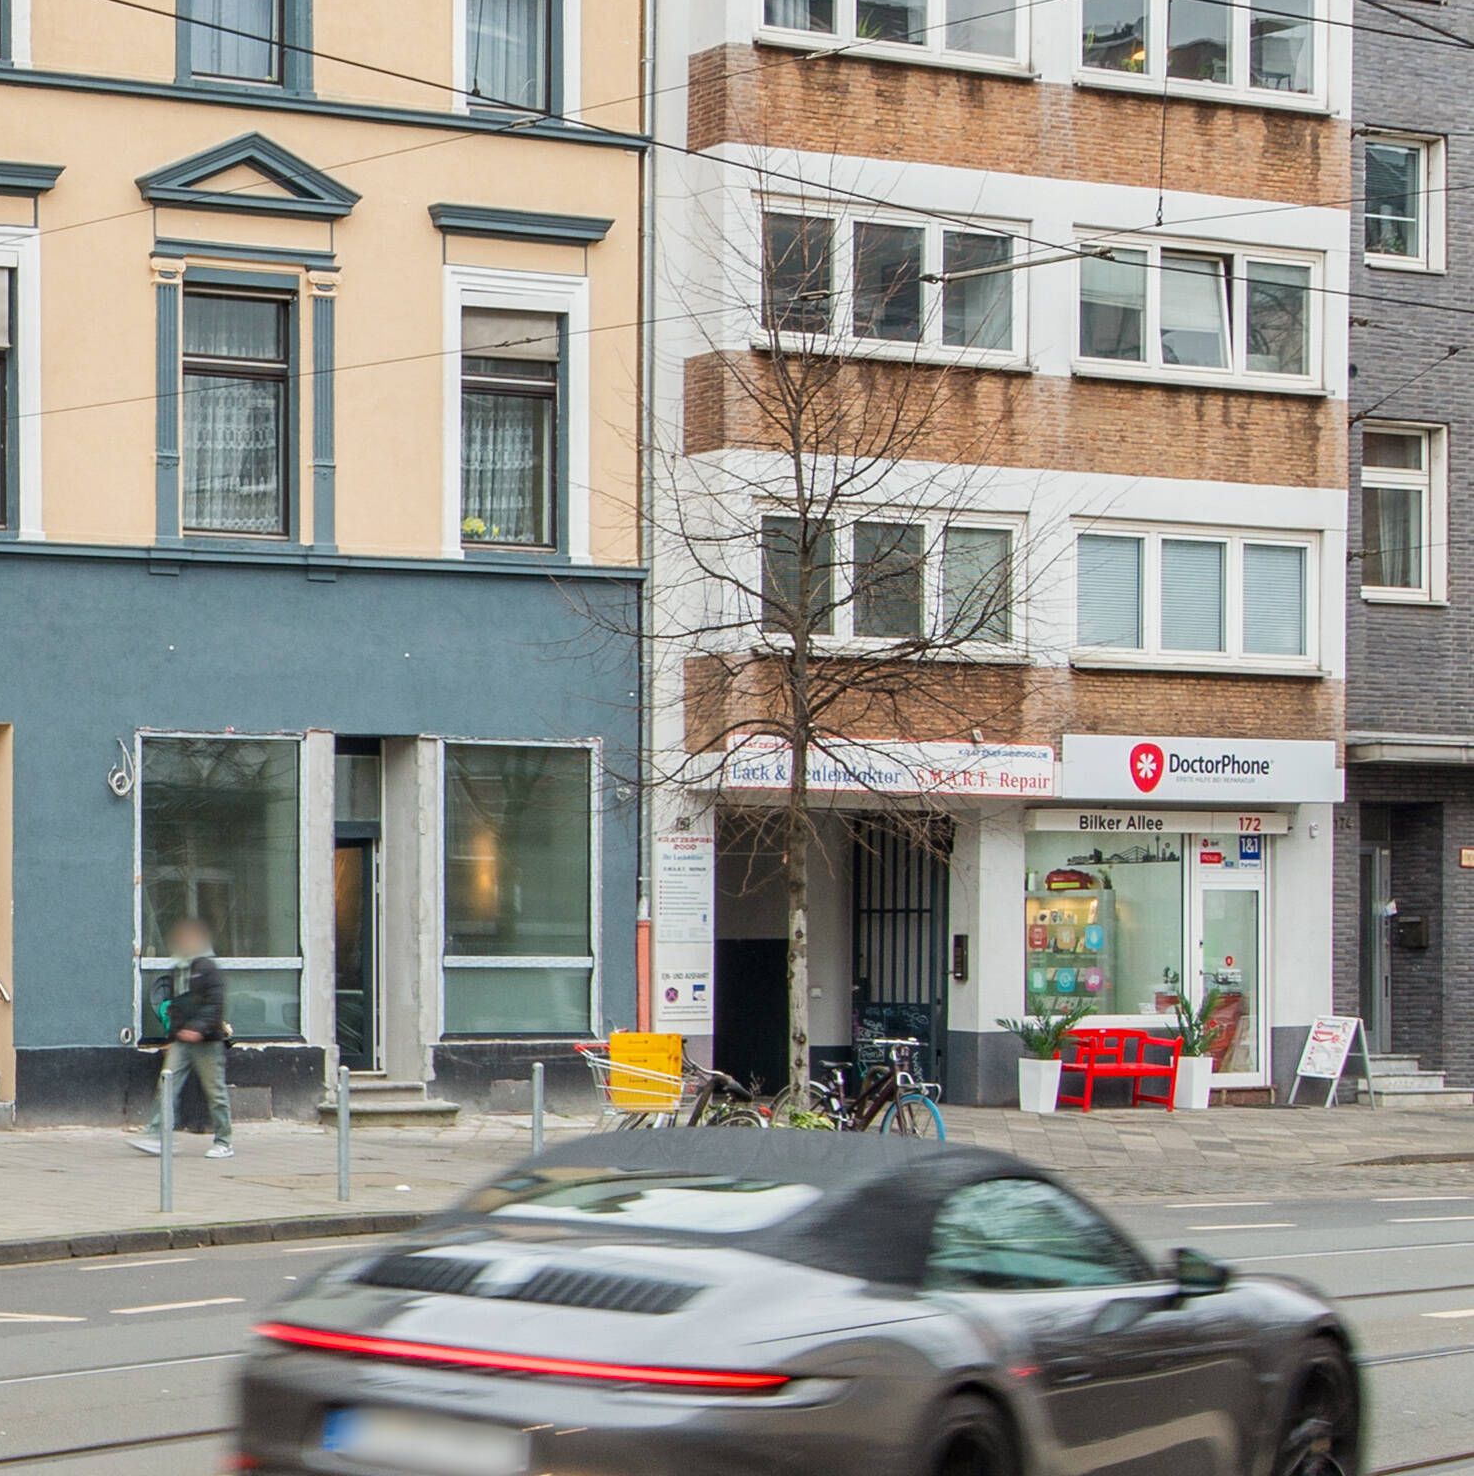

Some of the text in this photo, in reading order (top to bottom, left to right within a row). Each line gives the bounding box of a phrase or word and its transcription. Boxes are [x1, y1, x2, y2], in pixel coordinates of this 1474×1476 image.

[1169, 753, 1270, 775] DoctorPhone
[732, 763, 770, 781] Lack
[775, 764, 787, 781] &
[797, 765, 902, 785] eulendoktor
[1000, 772, 1050, 792] Repair
[1079, 815, 1261, 832] Bilker Allee 172
[1241, 838, 1258, 853] 1&1
